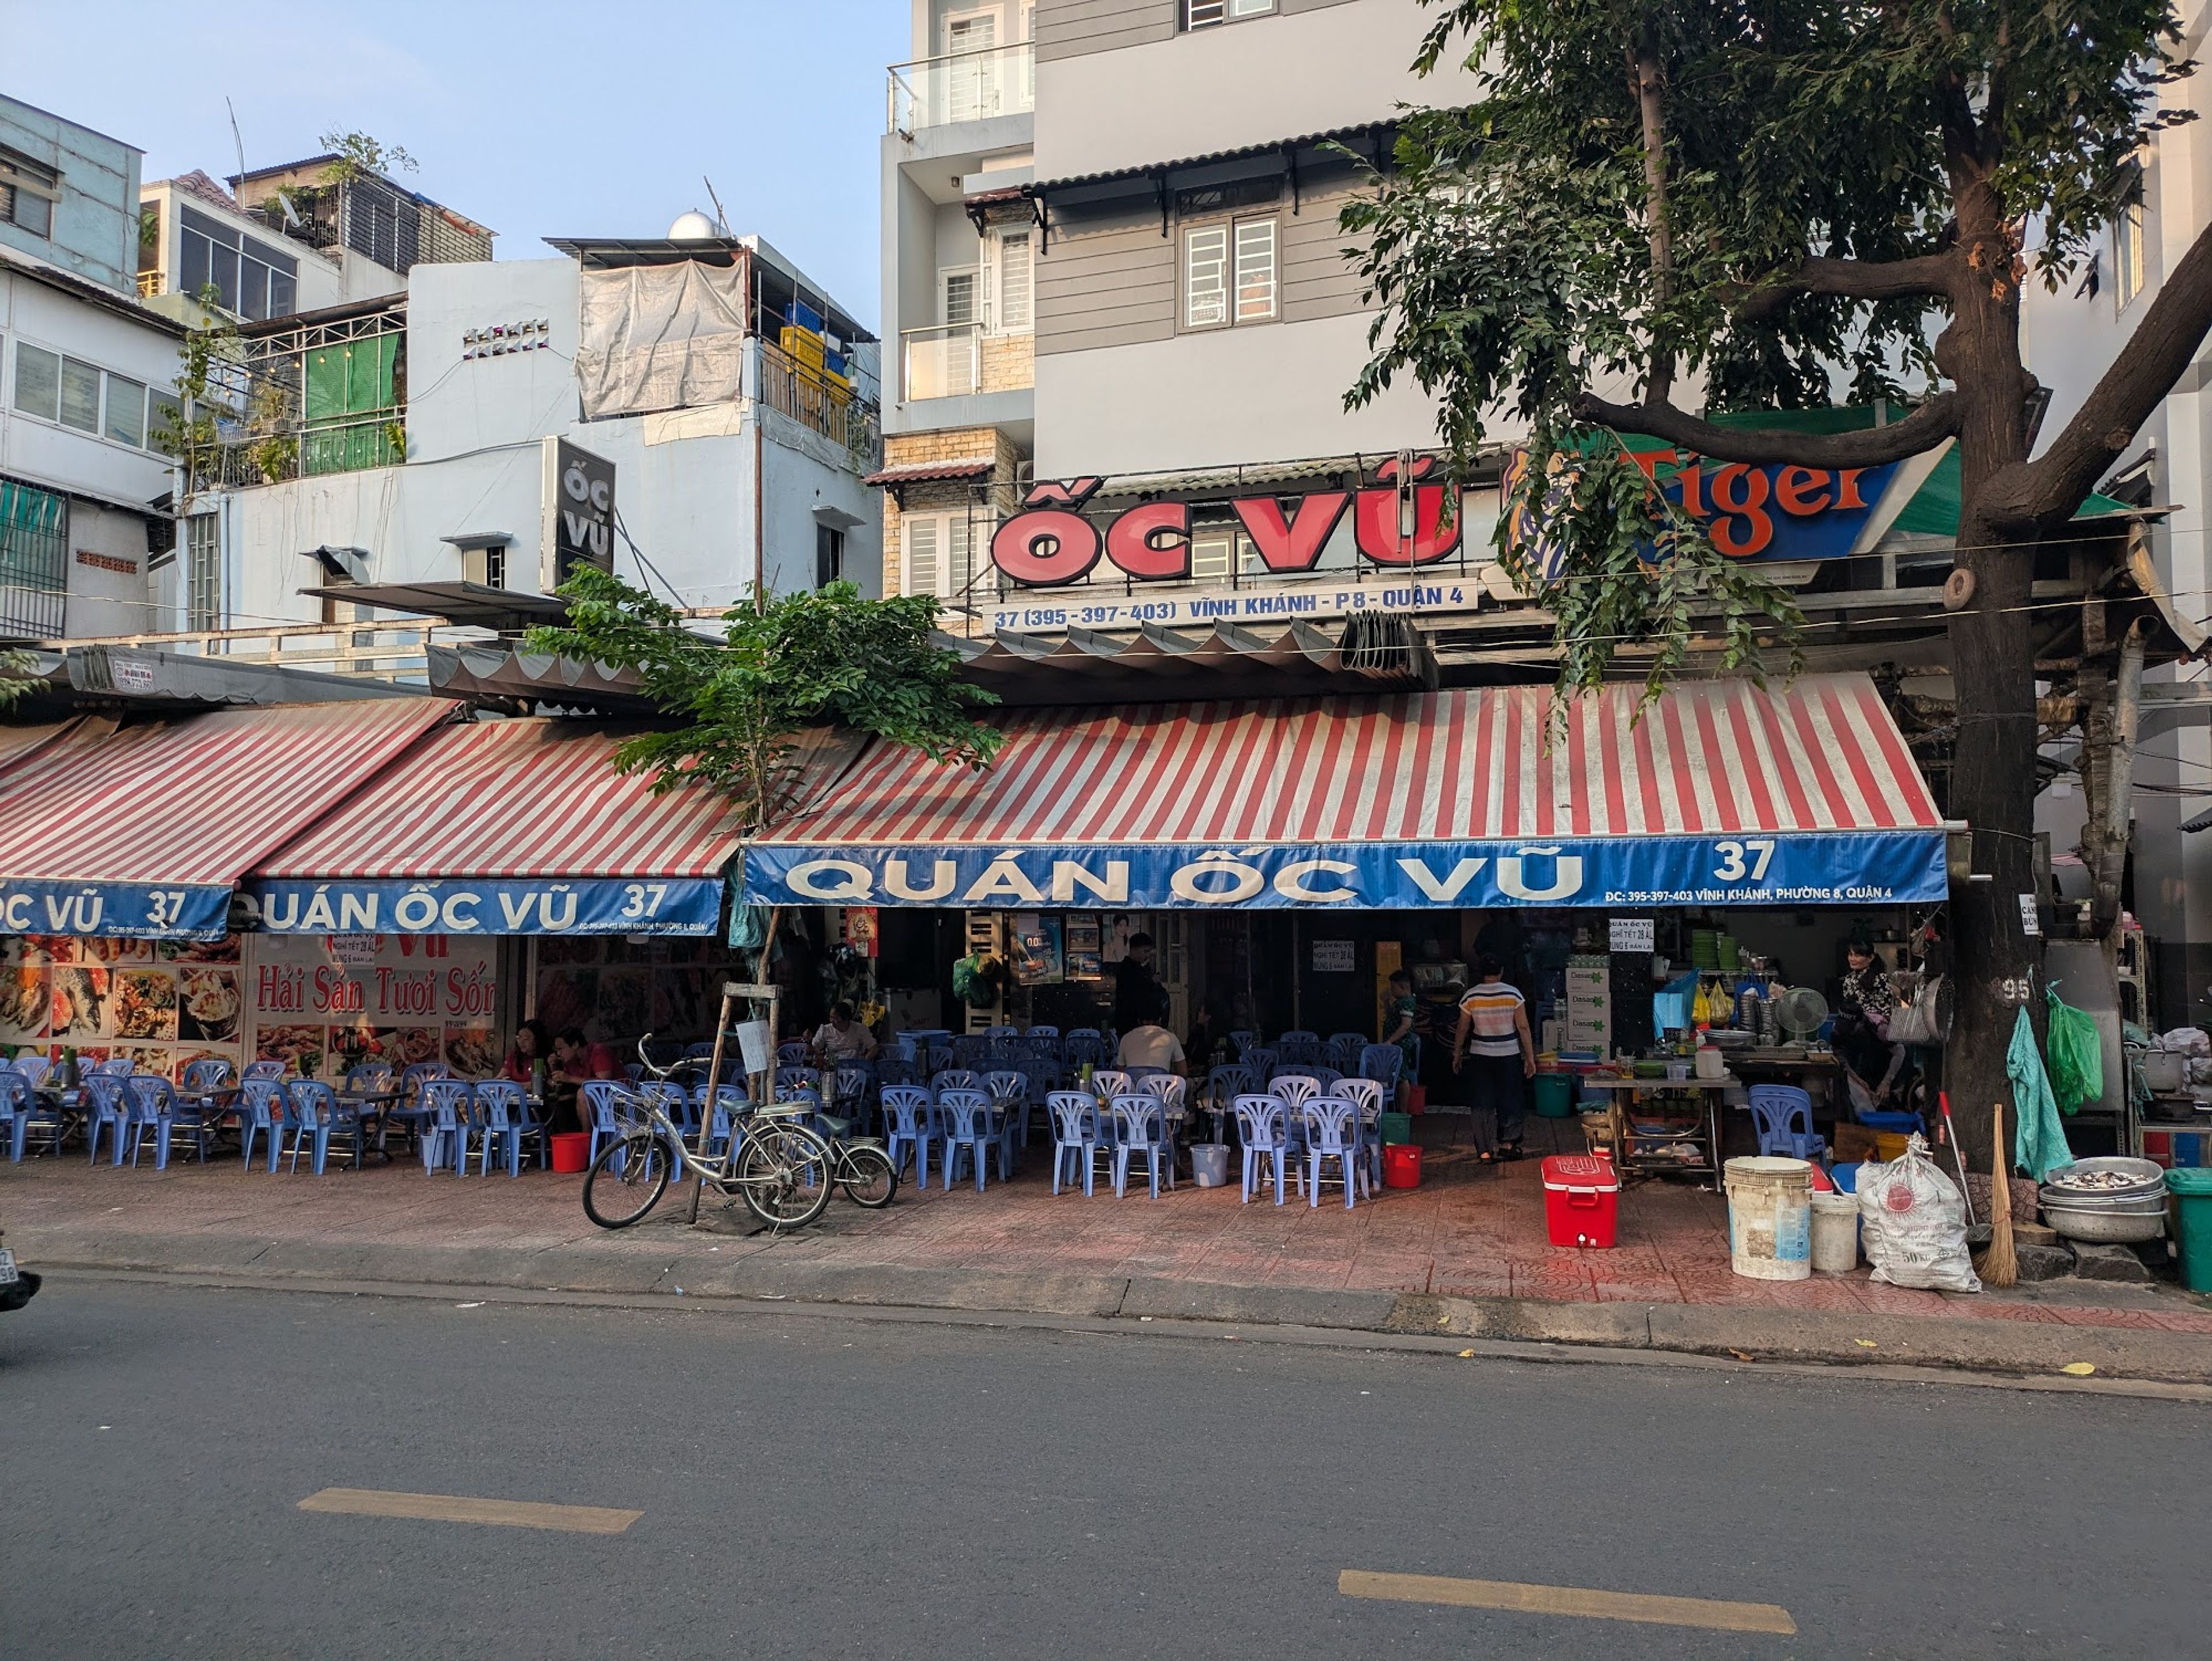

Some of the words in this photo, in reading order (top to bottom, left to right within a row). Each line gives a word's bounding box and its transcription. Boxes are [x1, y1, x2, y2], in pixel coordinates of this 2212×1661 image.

[564, 460, 609, 512] ỐC
[1618, 448, 1880, 556] Tiger
[563, 510, 609, 556] VŨ
[990, 476, 1192, 587] ỐC
[1229, 454, 1464, 574] VŨ
[994, 612, 1018, 627] 37
[1190, 597, 1237, 617] VĨNH
[1245, 593, 1316, 615] KHÁNH
[1382, 585, 1441, 609] QUẬN
[1450, 587, 1464, 604] 4
[786, 851, 1130, 902] QUÁN
[1170, 847, 1358, 902] ỐC
[1396, 847, 1583, 901] VŨ
[1713, 840, 1775, 881] 37
[1605, 892, 1626, 901] ĐC:
[1627, 890, 1693, 901] 395-397-403
[1695, 888, 1725, 901] VĨNH
[1728, 887, 1773, 901] KHÁNH,
[1776, 885, 1831, 898] PHƯỜNG
[1833, 888, 1843, 900] 8,
[1846, 885, 1882, 900] QUẬN
[1885, 888, 1892, 897] 4
[0, 882, 35, 930] C
[46, 888, 104, 932] VŨ
[146, 890, 186, 923] 37
[395, 879, 482, 930] ỐC
[498, 884, 578, 930] VŨ
[621, 884, 667, 917] 37
[257, 963, 305, 1011] Hải
[313, 963, 366, 1013] Sản
[376, 966, 437, 1014] Tươi
[445, 961, 496, 1015] Sốn
[1902, 1251, 1918, 1264] 50
